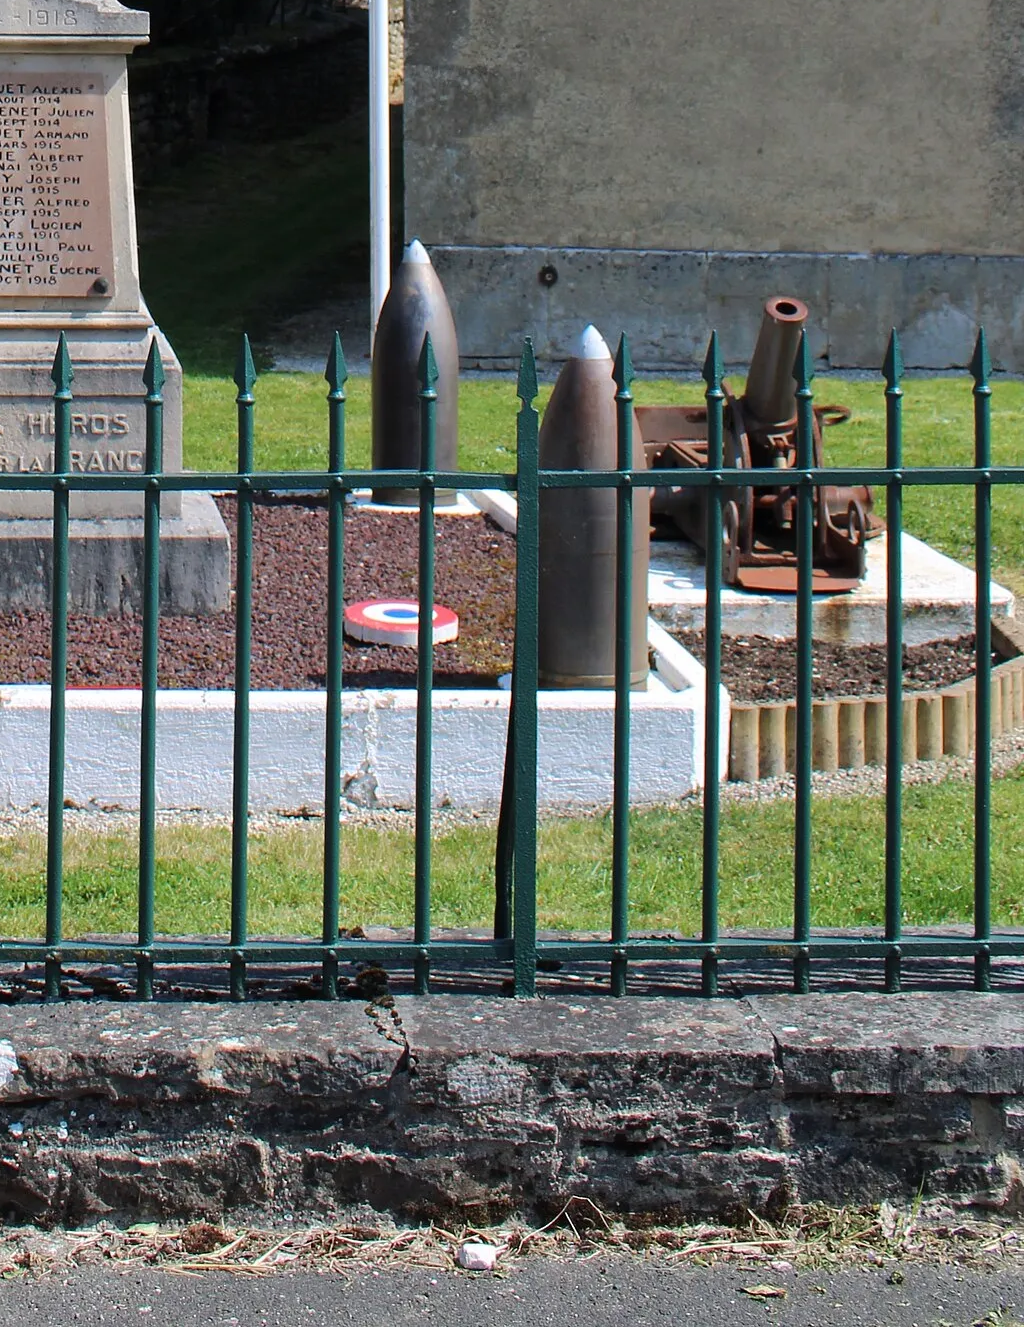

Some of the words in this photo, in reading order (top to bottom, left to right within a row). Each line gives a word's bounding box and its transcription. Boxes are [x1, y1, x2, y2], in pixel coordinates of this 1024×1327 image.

[27, 9, 78, 26] 1918
[32, 86, 82, 94] ALEXIS
[34, 96, 60, 104] 1914
[48, 108, 94, 117] JULIEN
[34, 131, 88, 139] ARMAND
[34, 141, 62, 149] 1915
[28, 153, 84, 162] ALBERT
[30, 163, 58, 171] 1915
[26, 174, 80, 184] JOSEPH
[32, 186, 59, 194] 1915
[35, 198, 90, 207] ALFRED
[34, 209, 60, 217] 1915
[31, 219, 82, 230] LUCIEN
[59, 242, 94, 252] PAUL
[31, 254, 59, 262] 1916
[29, 276, 57, 284] 1918
[18, 457, 43, 472] LA
[51, 450, 146, 472] RANC
